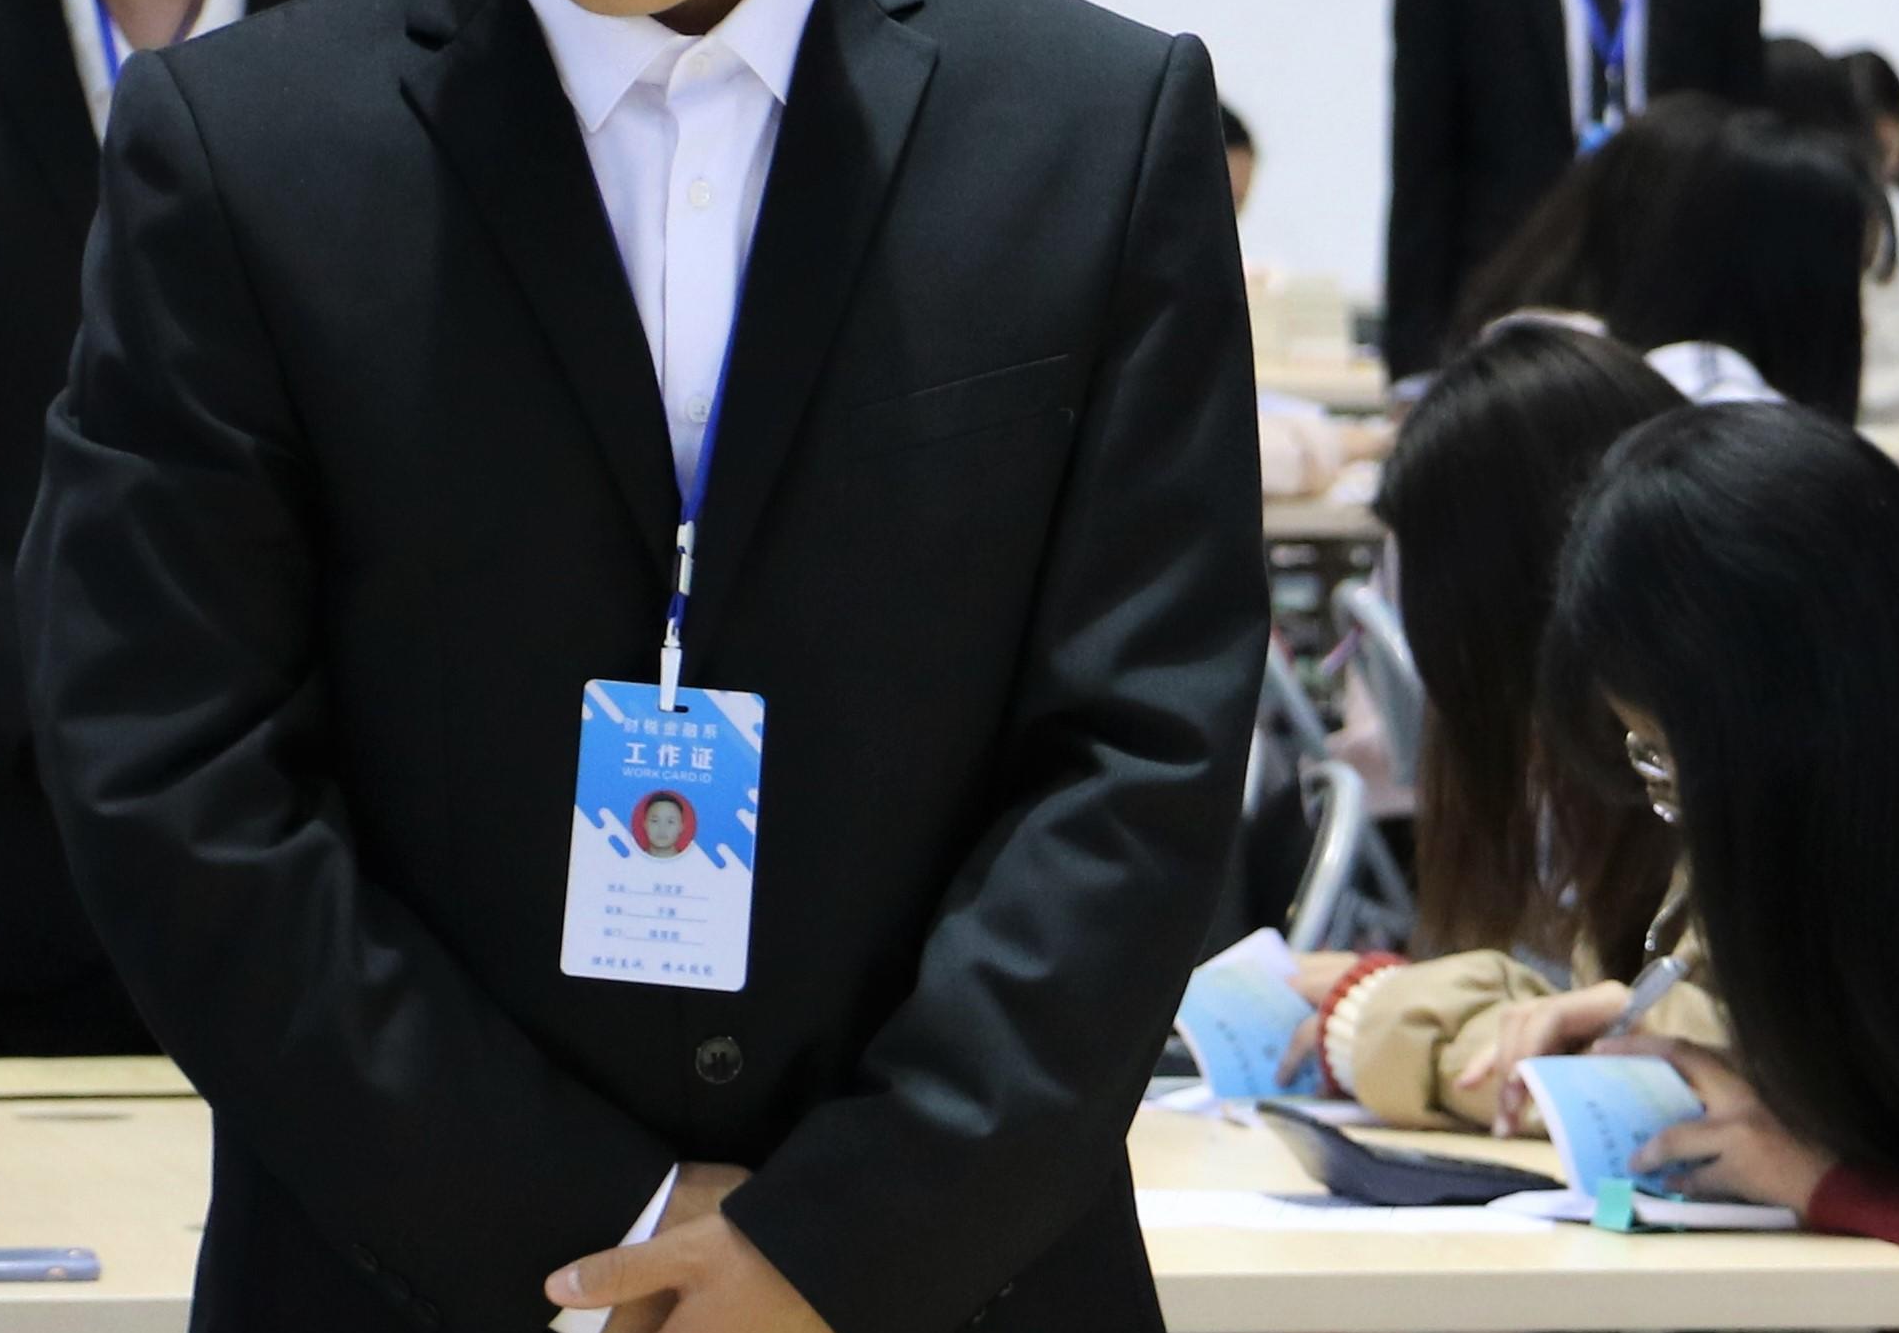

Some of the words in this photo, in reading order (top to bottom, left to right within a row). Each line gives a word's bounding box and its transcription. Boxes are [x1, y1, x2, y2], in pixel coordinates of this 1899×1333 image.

[623, 741, 715, 771] 工作证
[622, 766, 659, 779] WORK
[662, 770, 698, 782] CARD
